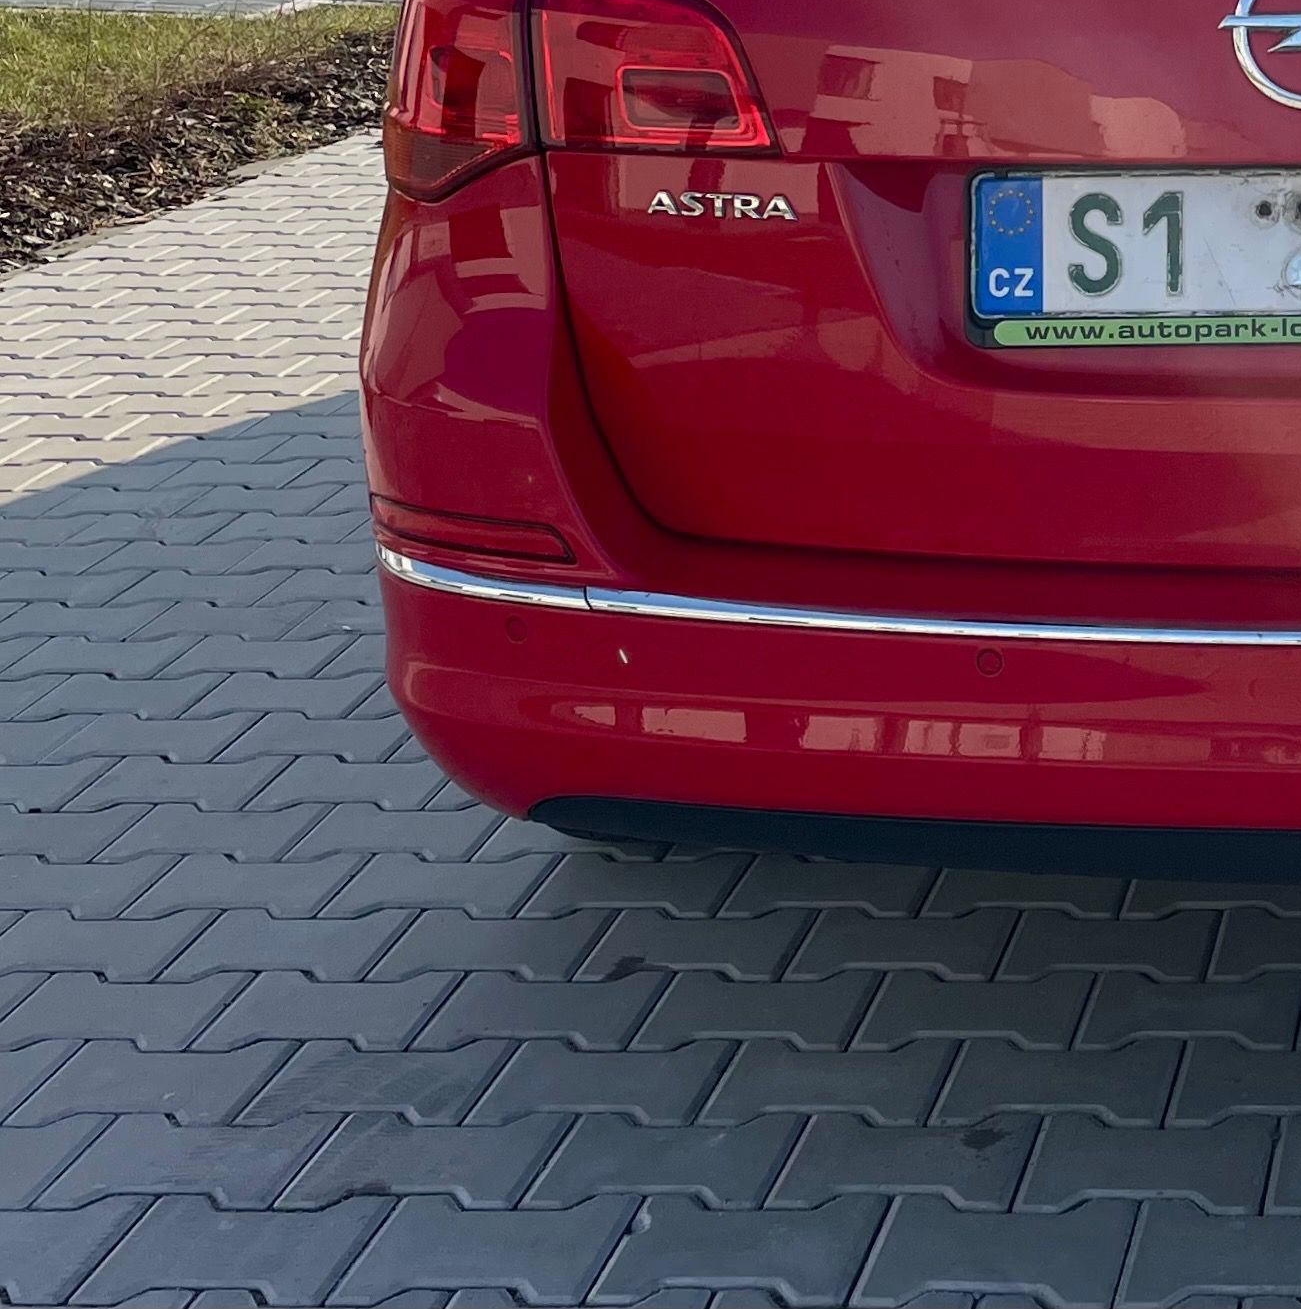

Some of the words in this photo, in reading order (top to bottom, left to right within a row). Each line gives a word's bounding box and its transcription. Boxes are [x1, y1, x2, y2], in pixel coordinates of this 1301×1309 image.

[647, 191, 799, 221] ASTRA
[1067, 191, 1185, 298] S1
[988, 267, 1035, 298] CZ
